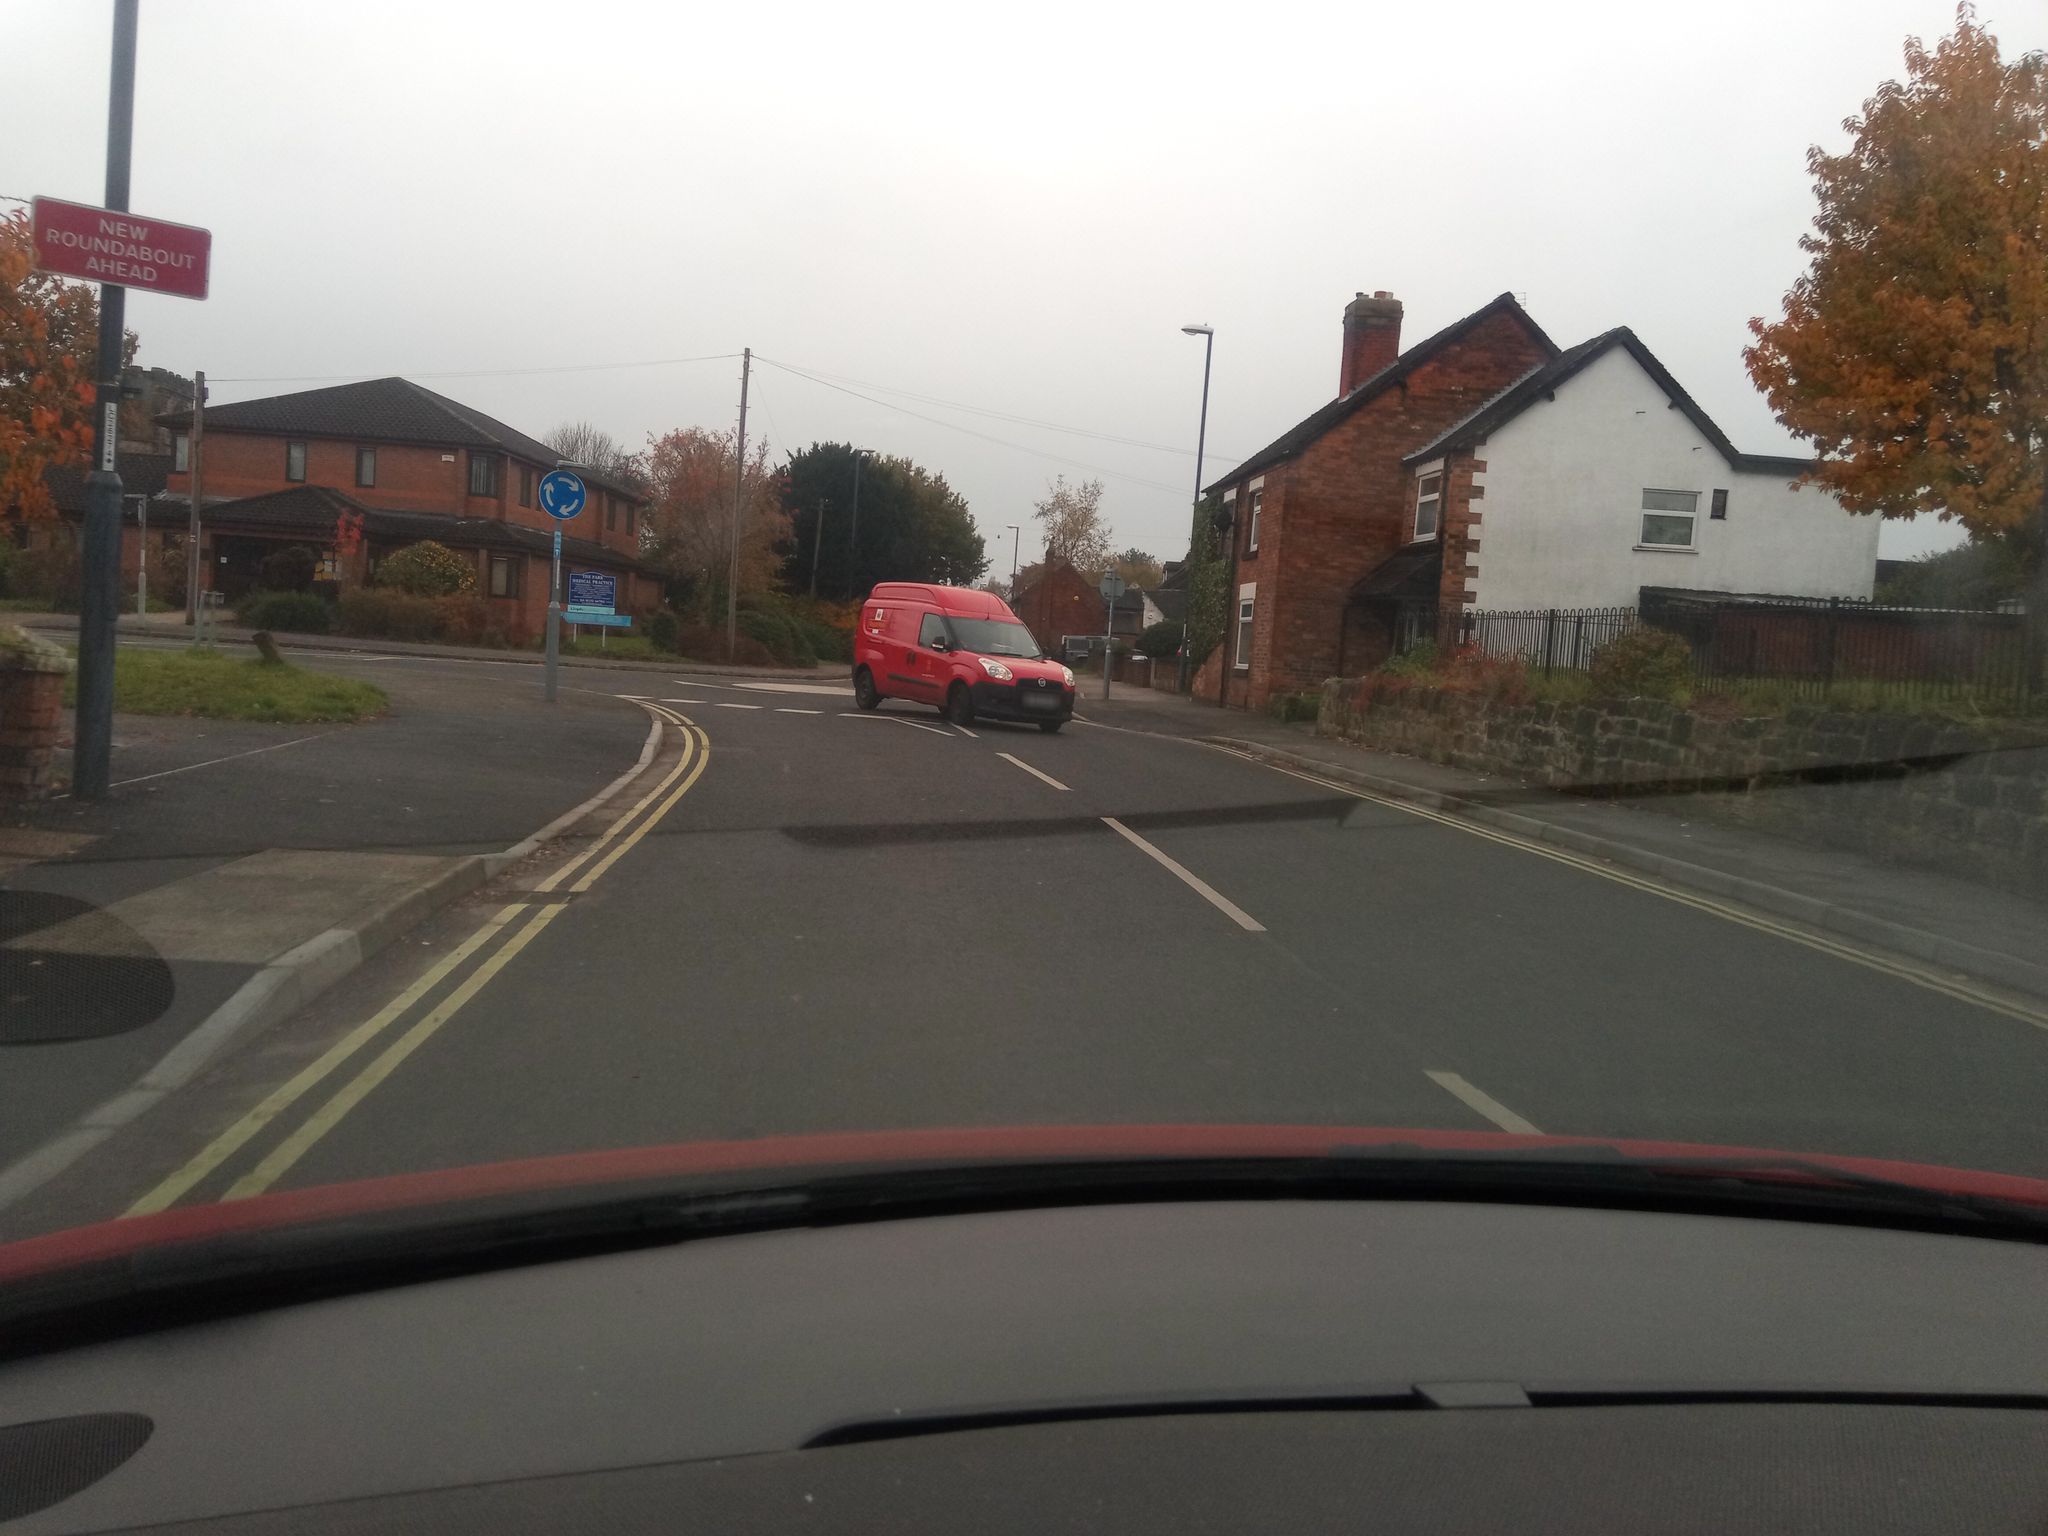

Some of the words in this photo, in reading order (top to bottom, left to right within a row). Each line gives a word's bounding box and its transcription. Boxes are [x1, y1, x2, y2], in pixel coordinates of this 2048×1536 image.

[99, 218, 148, 241] NEW
[46, 228, 196, 270] ROUNDABOUT
[87, 256, 157, 281] AHEAD
